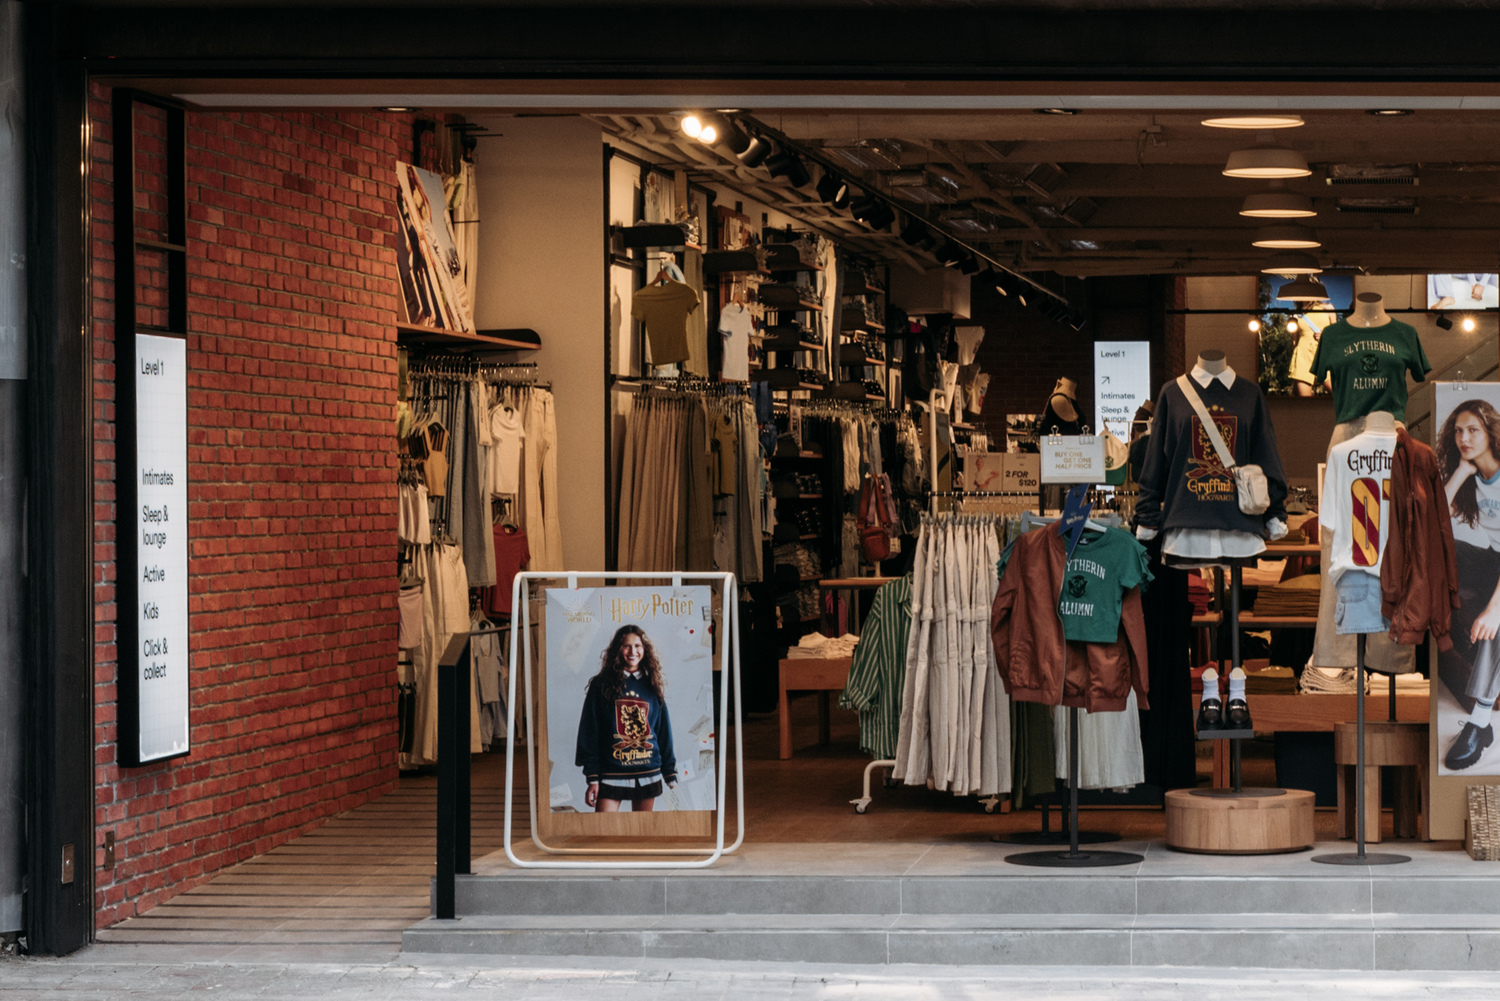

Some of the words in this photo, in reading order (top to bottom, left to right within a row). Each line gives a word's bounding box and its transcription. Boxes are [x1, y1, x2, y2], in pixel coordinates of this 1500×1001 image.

[1101, 350, 1120, 358] Level
[1122, 350, 1126, 358] 1
[1344, 341, 1396, 357] SLYTHERIN
[141, 357, 159, 377] Level
[160, 359, 164, 375] 1
[1353, 377, 1388, 389] ALUMNI
[1101, 406, 1122, 415] Sleep
[142, 468, 174, 486] Intimates
[1019, 479, 1037, 487] $120
[142, 504, 162, 526] Sleep
[162, 504, 169, 521] &
[143, 528, 166, 549] lounge
[143, 564, 165, 583] Active
[1065, 557, 1106, 581] YTHERIN
[143, 602, 159, 620] Kids
[609, 597, 650, 624] Harry
[652, 594, 694, 622] Potter
[1060, 601, 1094, 617] ALUMNI
[144, 637, 160, 656] Click
[161, 637, 168, 655] &
[144, 662, 167, 682] collect
